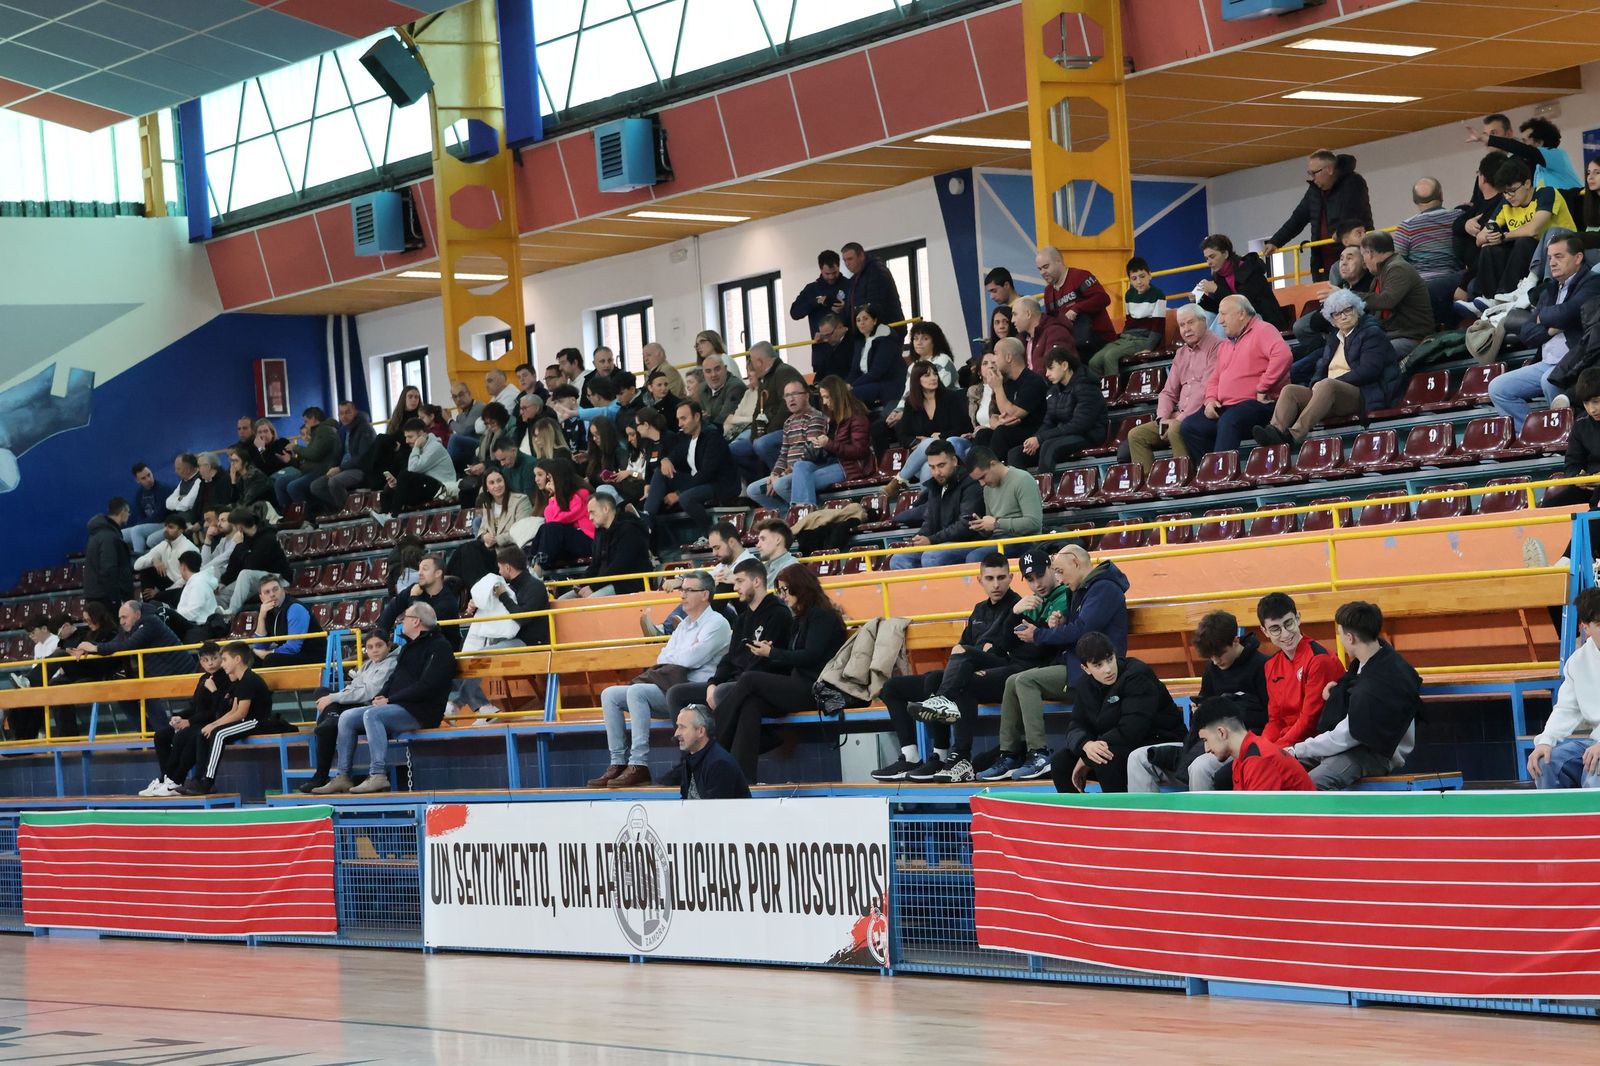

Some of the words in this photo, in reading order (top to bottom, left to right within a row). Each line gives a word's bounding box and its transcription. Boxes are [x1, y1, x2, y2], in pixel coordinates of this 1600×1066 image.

[1483, 422, 1495, 434] 11
[1543, 413, 1560, 427] 13
[430, 842, 453, 905] UN
[453, 842, 556, 917] SENTIMIENTO,
[558, 843, 593, 908] UNA
[596, 832, 665, 910] AFICIÓN.
[667, 842, 744, 913] ¡LUCHAR
[744, 842, 783, 914] POR
[786, 842, 887, 917] NOSOTROS!
[645, 924, 666, 947] ZAMORA
